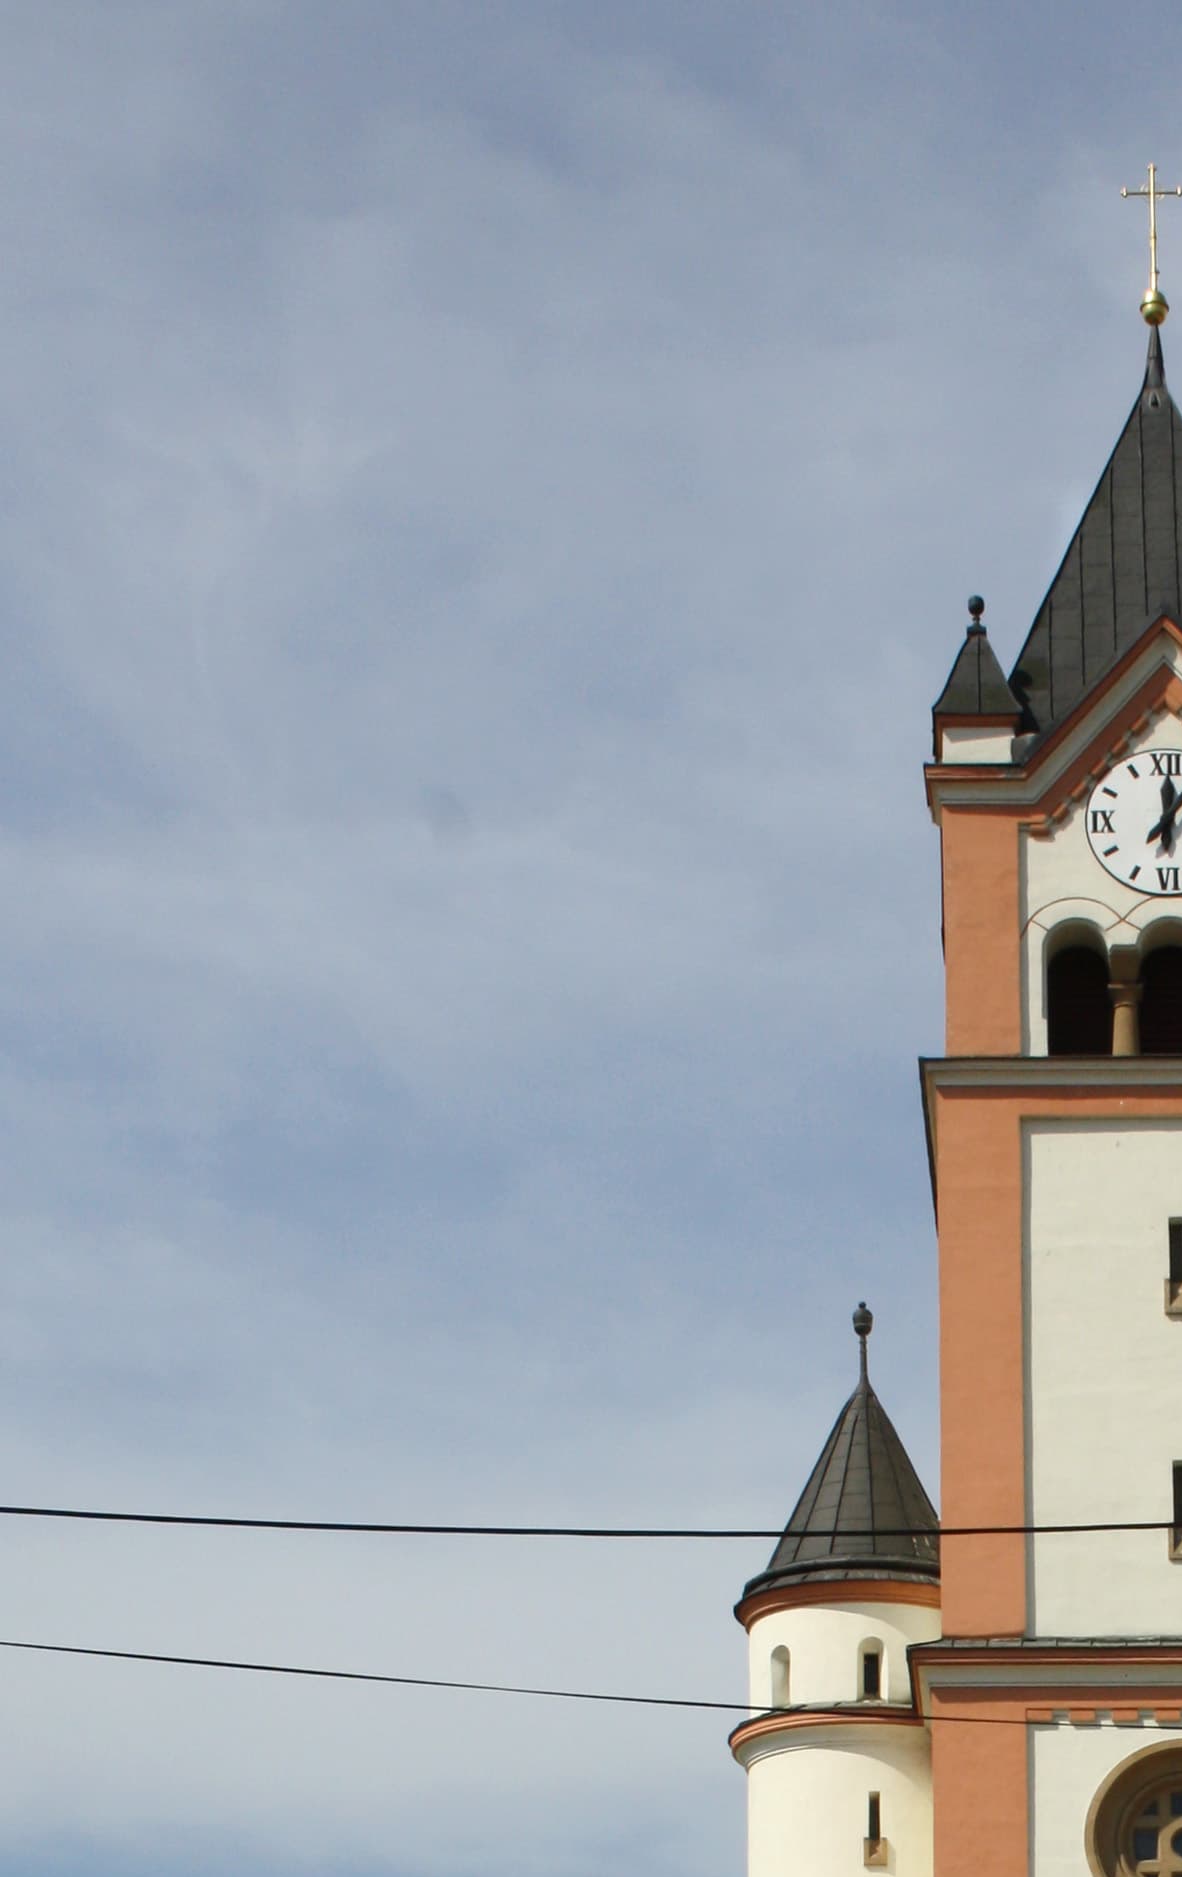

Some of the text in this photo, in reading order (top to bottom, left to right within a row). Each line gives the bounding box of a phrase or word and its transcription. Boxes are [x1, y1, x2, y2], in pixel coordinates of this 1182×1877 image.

[1150, 753, 1181, 776] XII
[1091, 810, 1115, 833] IX
[1156, 867, 1181, 891] VI
